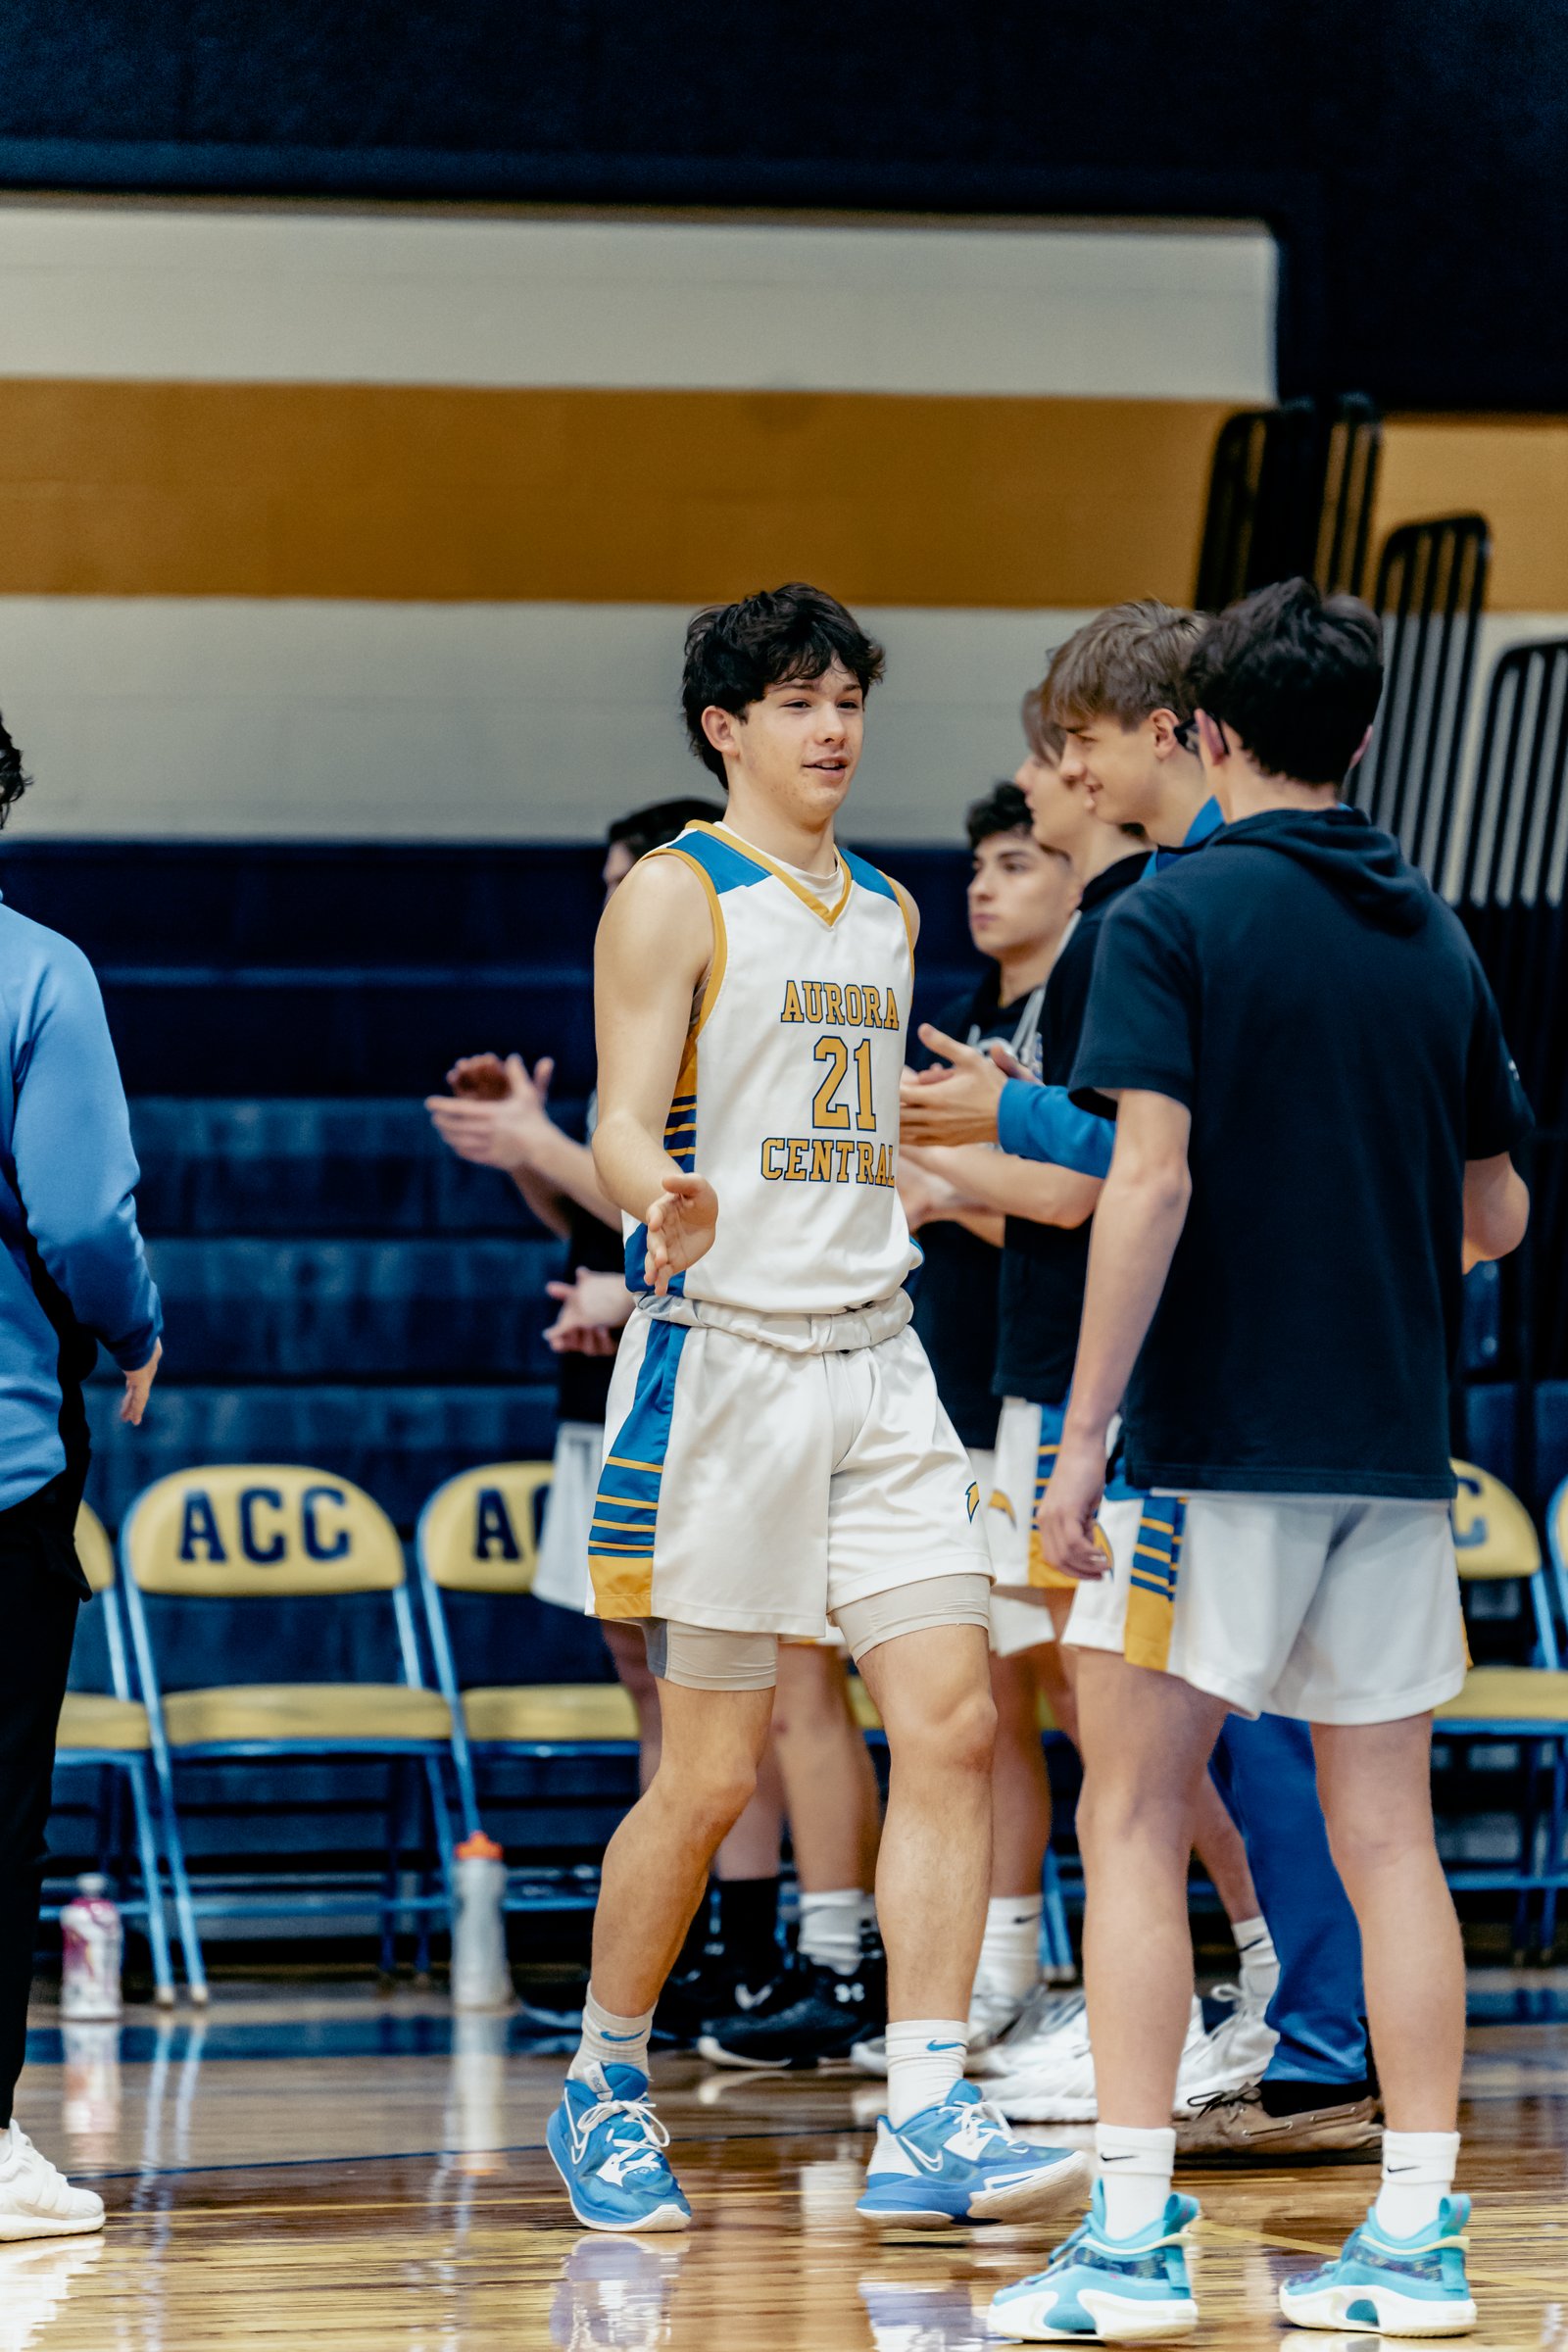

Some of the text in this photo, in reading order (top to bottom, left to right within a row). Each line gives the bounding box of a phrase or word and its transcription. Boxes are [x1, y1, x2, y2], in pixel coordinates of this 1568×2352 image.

[780, 980, 900, 1031] AURORA
[811, 1035, 877, 1132] 21
[760, 1137, 896, 1188] CENTRAL
[177, 1486, 351, 1564] ACC
